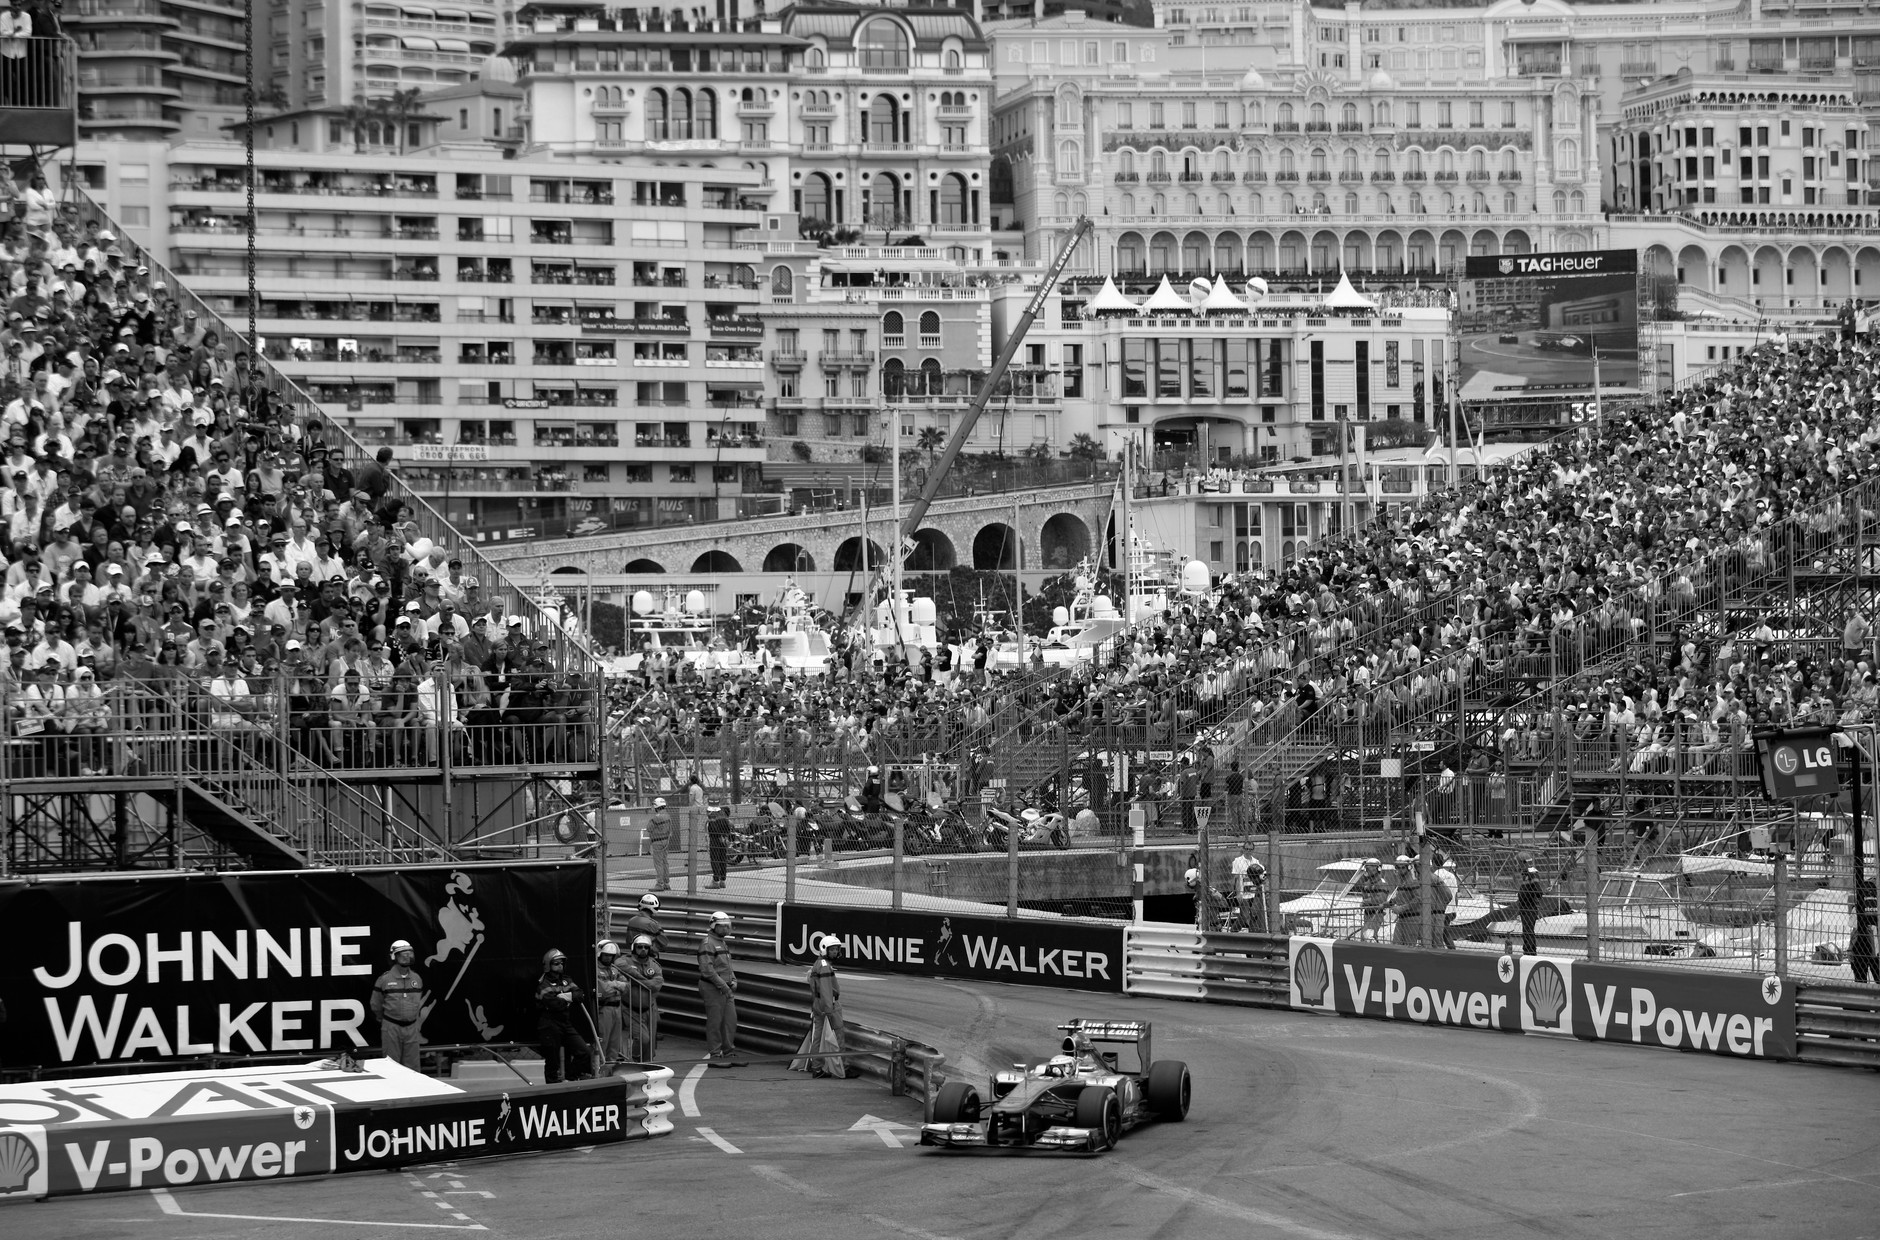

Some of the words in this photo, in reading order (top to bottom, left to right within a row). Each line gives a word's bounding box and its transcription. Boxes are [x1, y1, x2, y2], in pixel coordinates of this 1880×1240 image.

[614, 323, 635, 331] Security
[746, 326, 762, 334] Piracy
[613, 500, 639, 511] AVIS
[658, 500, 684, 511] AVIS
[1803, 747, 1832, 768] LG
[33, 921, 373, 989] JOHNNIE
[788, 924, 924, 964] JOHNNIE
[962, 934, 1111, 980] WALKER
[1343, 963, 1507, 1029] V-Power
[1583, 982, 1773, 1056] V-Power
[43, 993, 370, 1062] WALKER
[344, 1118, 486, 1162] JOHNNIE
[518, 1104, 621, 1140] WALKER
[64, 1136, 306, 1192] V-Power
